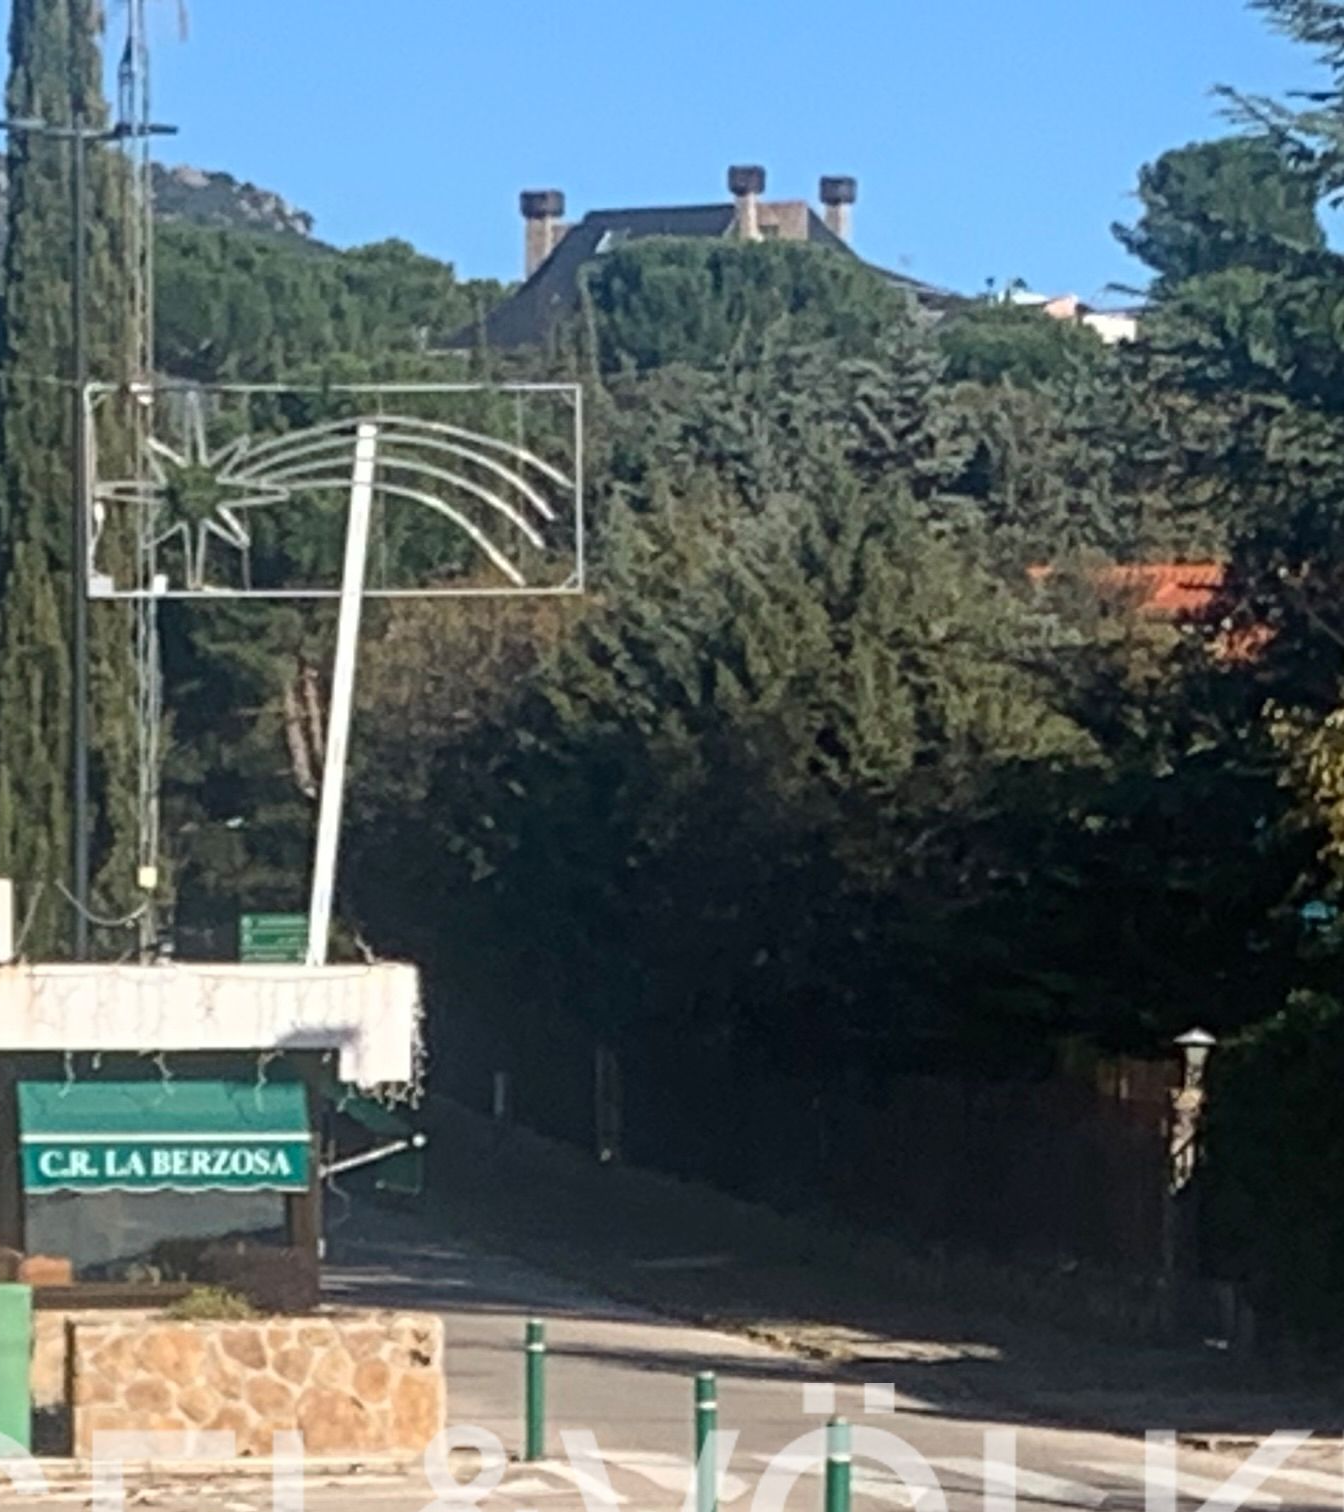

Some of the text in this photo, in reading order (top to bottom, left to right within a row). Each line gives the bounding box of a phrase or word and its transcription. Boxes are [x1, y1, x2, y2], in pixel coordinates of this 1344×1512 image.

[39, 1148, 292, 1178] C.R. LA BERZOSA
